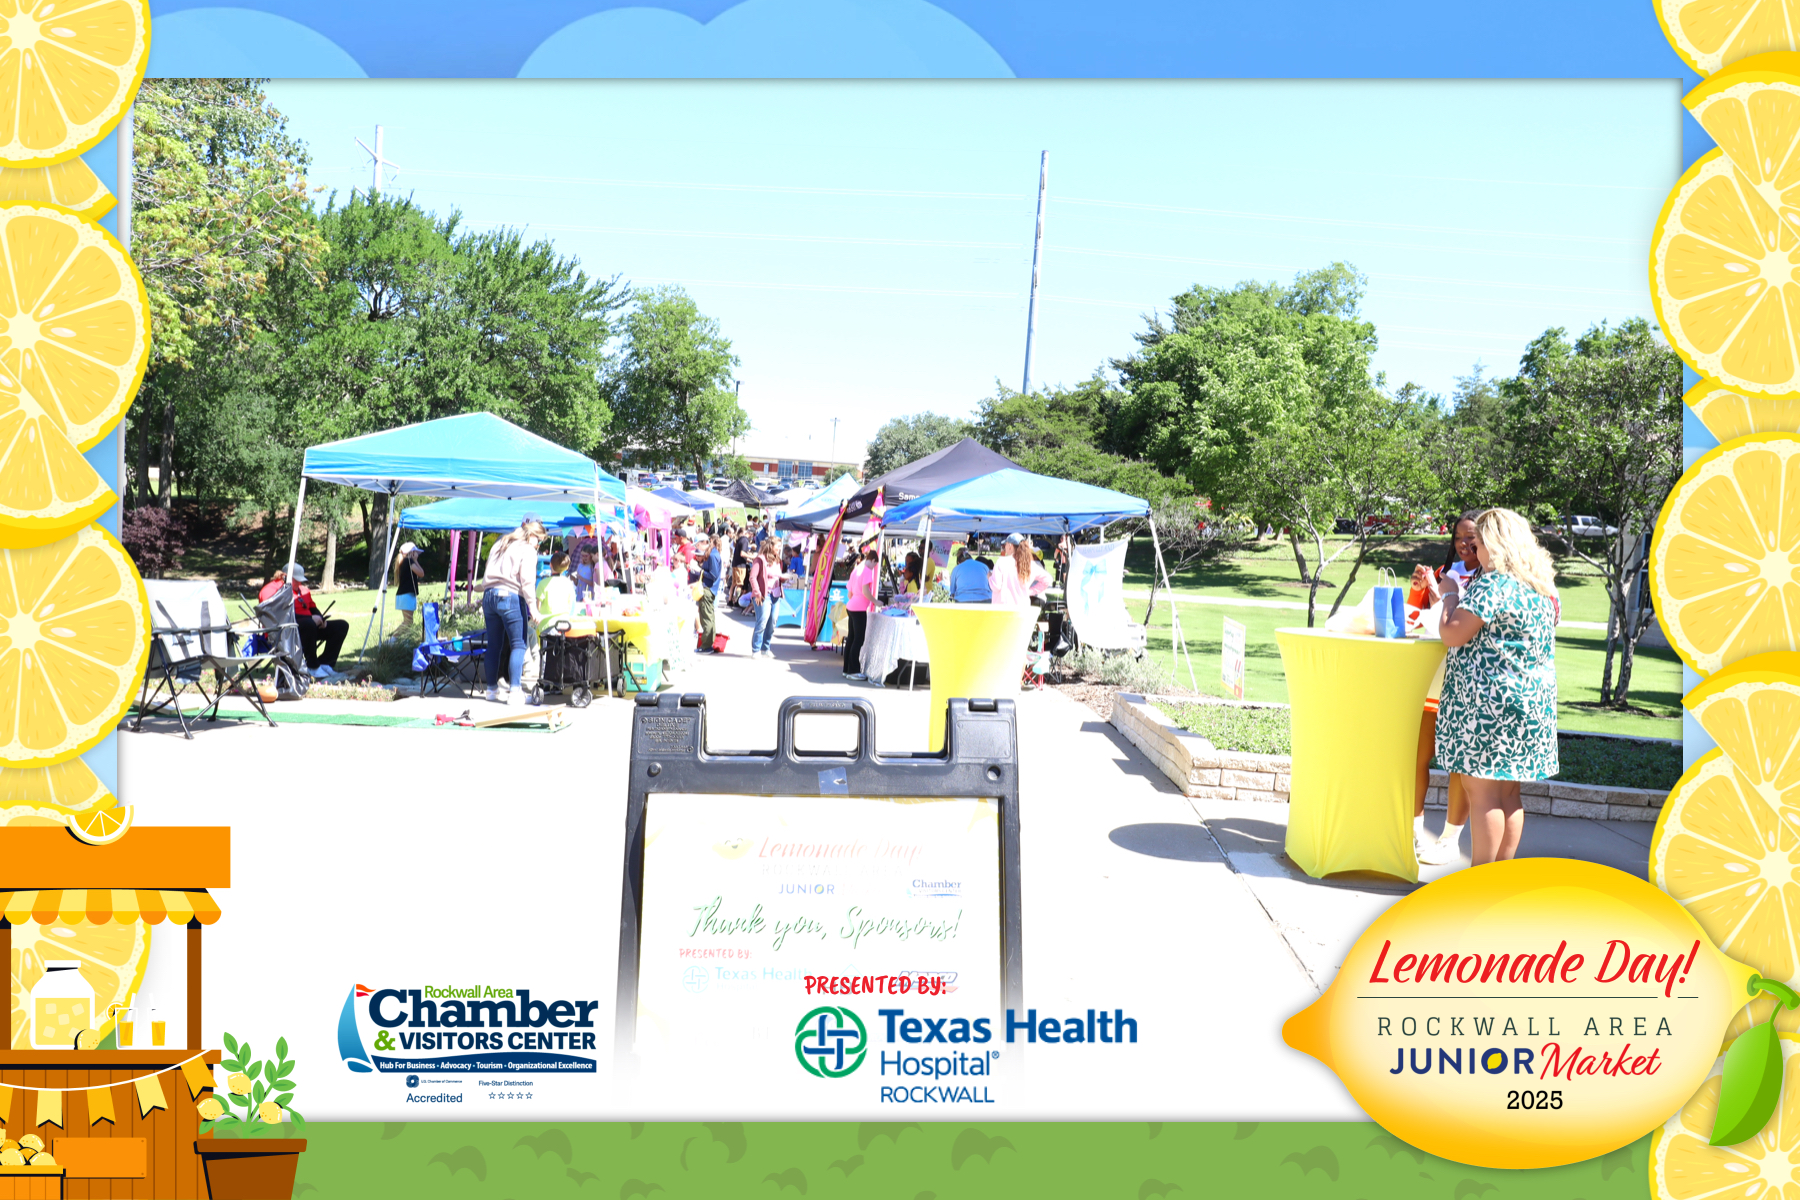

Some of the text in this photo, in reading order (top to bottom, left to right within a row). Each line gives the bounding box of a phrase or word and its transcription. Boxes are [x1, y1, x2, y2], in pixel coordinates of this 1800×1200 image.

[758, 836, 867, 858] Lemonade
[778, 883, 835, 895] JUNIOR
[912, 878, 962, 888] Chamber
[687, 896, 963, 952] Thank you, Sponsors!
[679, 948, 753, 959] PRESENTED BY:
[715, 966, 757, 980] Texas
